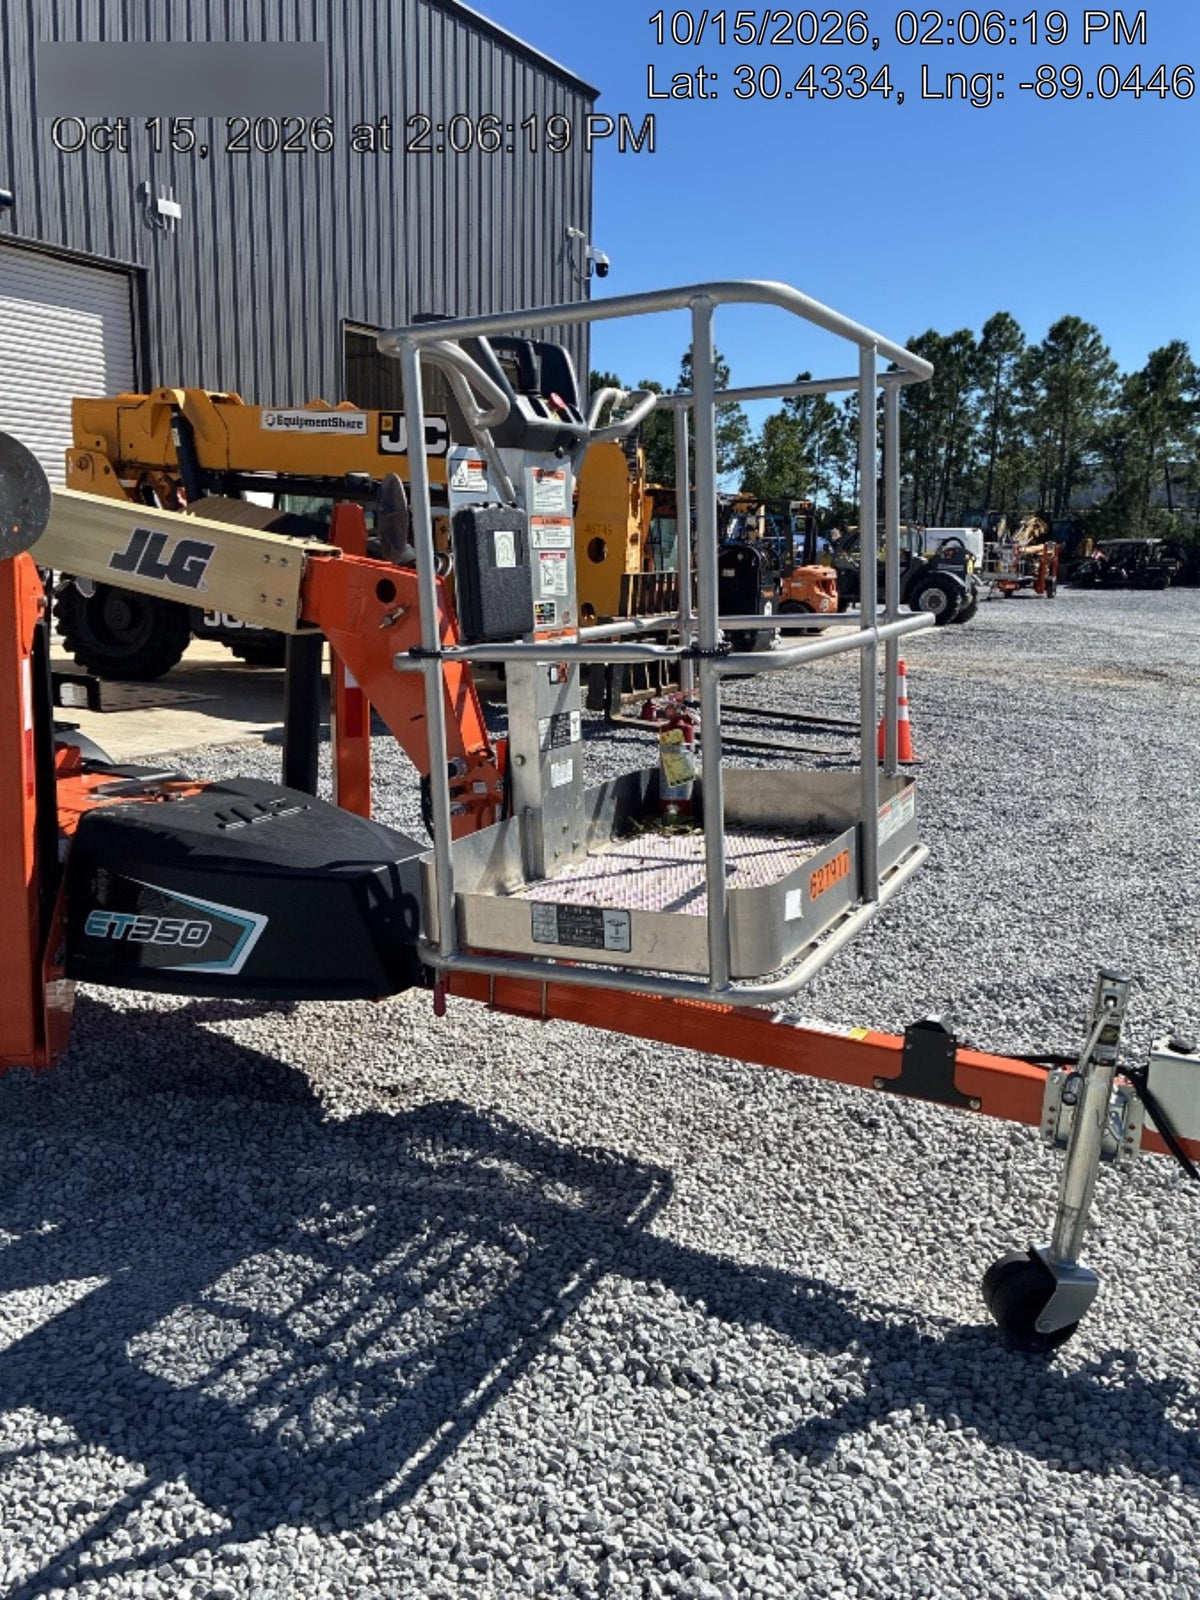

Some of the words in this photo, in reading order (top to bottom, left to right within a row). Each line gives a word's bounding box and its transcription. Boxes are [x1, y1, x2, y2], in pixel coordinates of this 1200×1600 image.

[276, 414, 363, 430] EquipmentShare
[380, 416, 448, 454] JC
[107, 527, 217, 590] JLG
[85, 909, 212, 948] ET350
